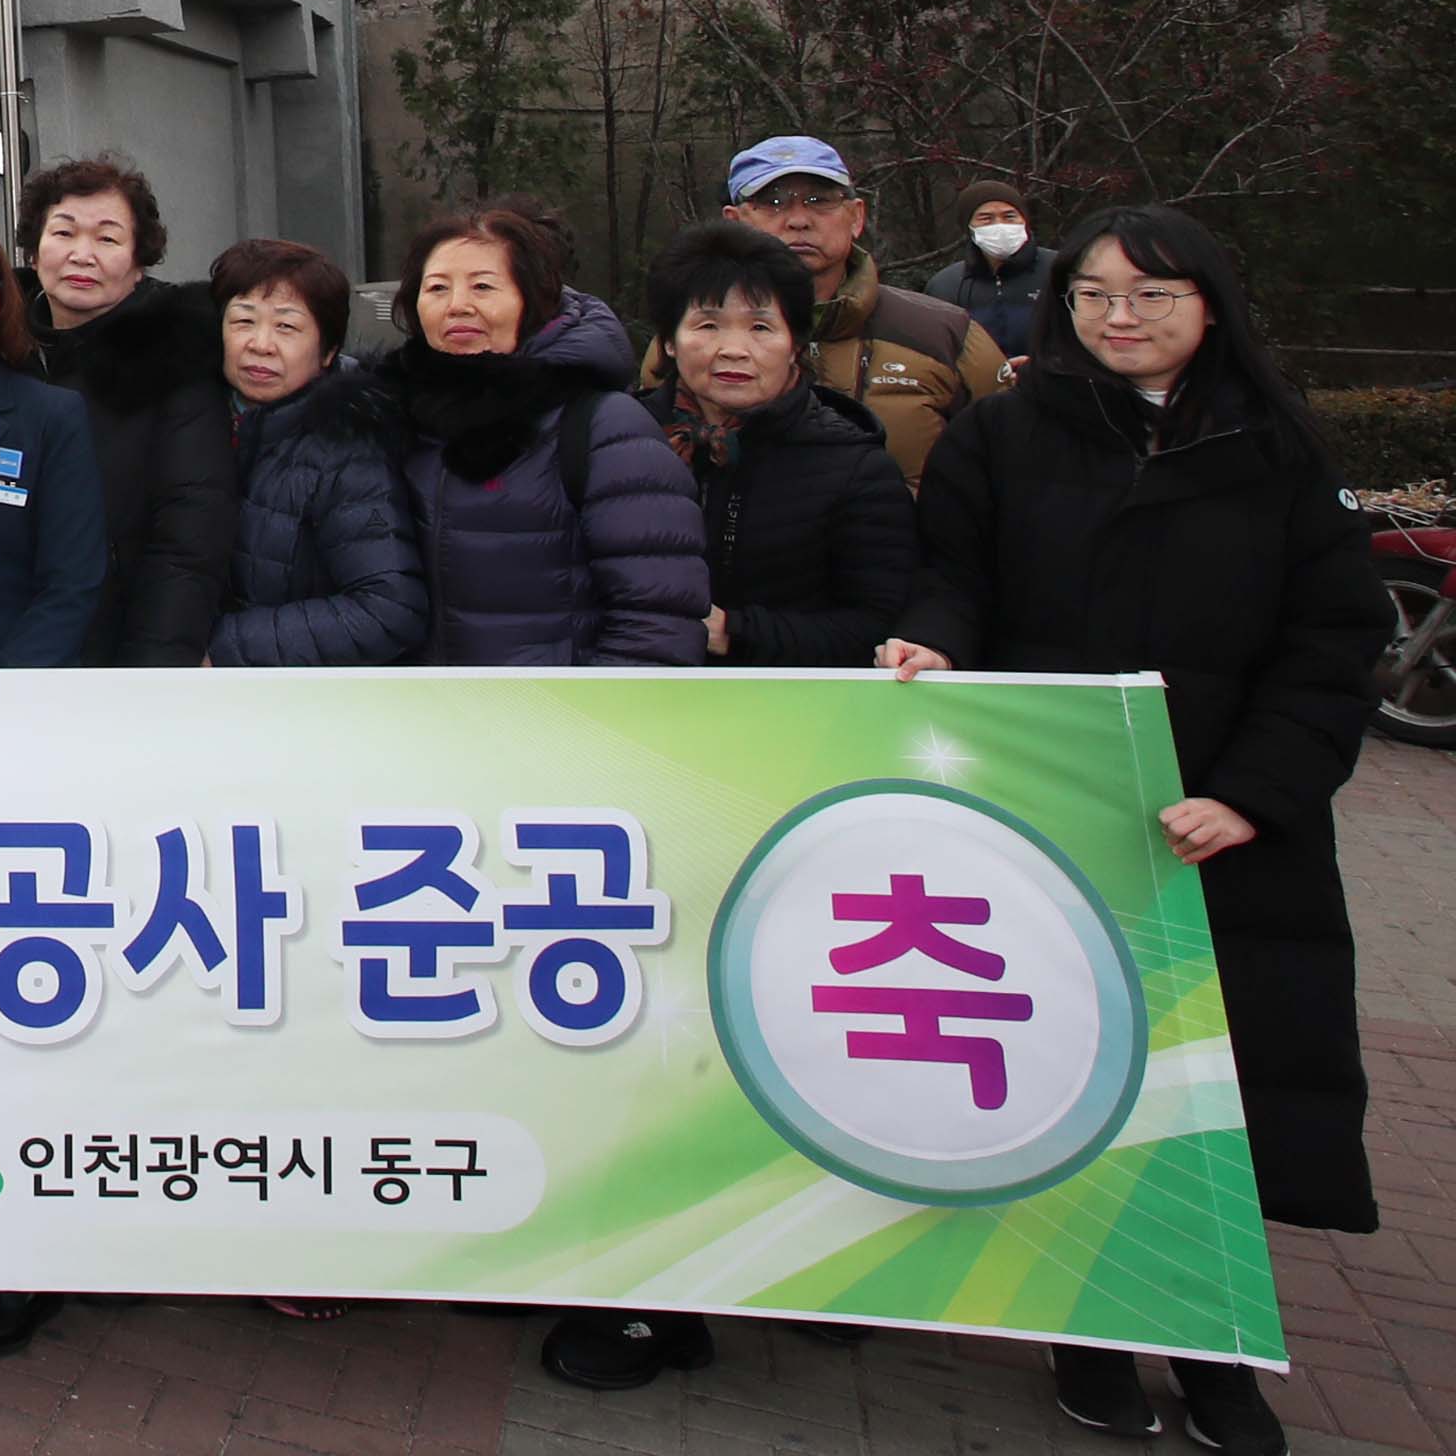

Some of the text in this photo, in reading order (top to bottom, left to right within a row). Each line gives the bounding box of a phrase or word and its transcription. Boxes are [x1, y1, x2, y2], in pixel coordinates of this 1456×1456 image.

[341, 822, 655, 1032] 준공
[811, 874, 1034, 1111] 축
[18, 1133, 334, 1201] 인천광역시
[360, 1137, 488, 1206] 동구
